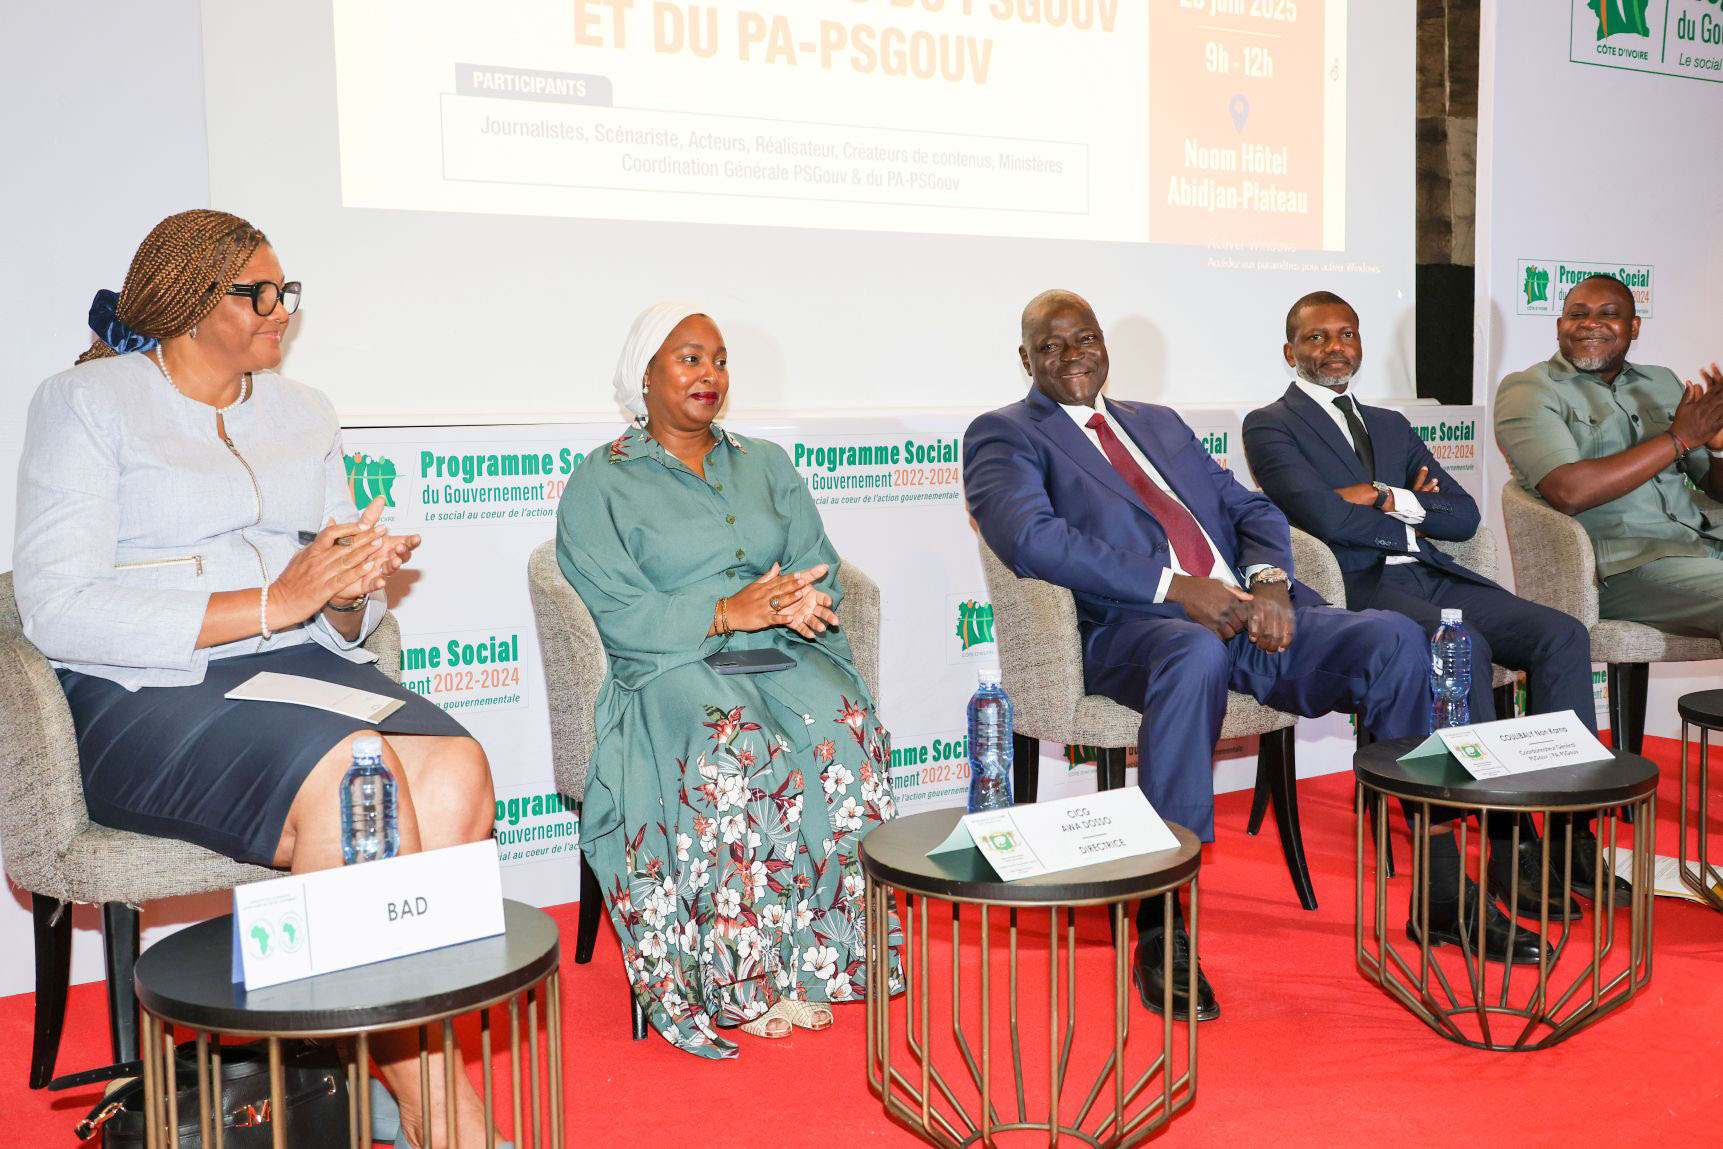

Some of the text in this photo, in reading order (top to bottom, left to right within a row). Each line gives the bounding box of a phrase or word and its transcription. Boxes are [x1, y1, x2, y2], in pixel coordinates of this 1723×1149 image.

[1677, 10, 1723, 45] du Go
[573, 0, 994, 85] ET DU PA-PSGOUV
[1596, 44, 1649, 60] CÔTE D'IVOIRE
[1204, 41, 1230, 73] 9h
[1243, 47, 1274, 78] 12h
[1679, 52, 1723, 71] Le social
[472, 71, 586, 97] PARTICIPANTS
[480, 115, 1064, 175] Journalistes, Scénariste, Acteurs, Réalisateur, Créateurs de contenus, Ministères
[1183, 136, 1288, 176] Noom Hôtel
[621, 153, 960, 191] Coordination Générale PSGouv & du PA-PSGouv
[1168, 175, 1310, 215] Abidjan-Plateau
[1619, 268, 1650, 287] Social
[1632, 290, 1649, 304] 024
[1440, 420, 1475, 442] Social
[1202, 432, 1228, 454] cial
[1432, 444, 1474, 460] 2022-2024
[794, 438, 959, 473] Programme Social
[421, 451, 554, 484] Programme
[812, 471, 892, 490] Gouvernement
[894, 467, 959, 487] 2022-2024
[422, 484, 440, 505] du
[444, 482, 545, 504] Gouvernement
[814, 496, 829, 505] cial
[841, 495, 861, 503] coeur
[862, 494, 872, 503] de
[873, 493, 899, 502] l'action
[900, 491, 959, 503] gouvernementale
[425, 512, 437, 521] Le
[438, 510, 465, 521] social
[467, 511, 479, 520] au
[480, 510, 506, 520] coeur
[507, 509, 520, 518] de
[521, 507, 553, 518] l'action
[447, 634, 518, 667] Social
[433, 667, 520, 693] 2022-2024
[443, 693, 521, 711] gouvernementale
[932, 735, 968, 762] Soci
[921, 762, 970, 785] 2022-20
[927, 786, 969, 800] gouverneme
[1061, 817, 1112, 832] AWA DOSSO
[1067, 808, 1091, 819] CICG
[512, 851, 523, 860] au
[525, 847, 550, 858] coeur
[551, 844, 562, 854] de
[564, 842, 580, 852] l'ac
[1078, 838, 1127, 855] DIRECTRICE
[388, 897, 428, 921] BAD
